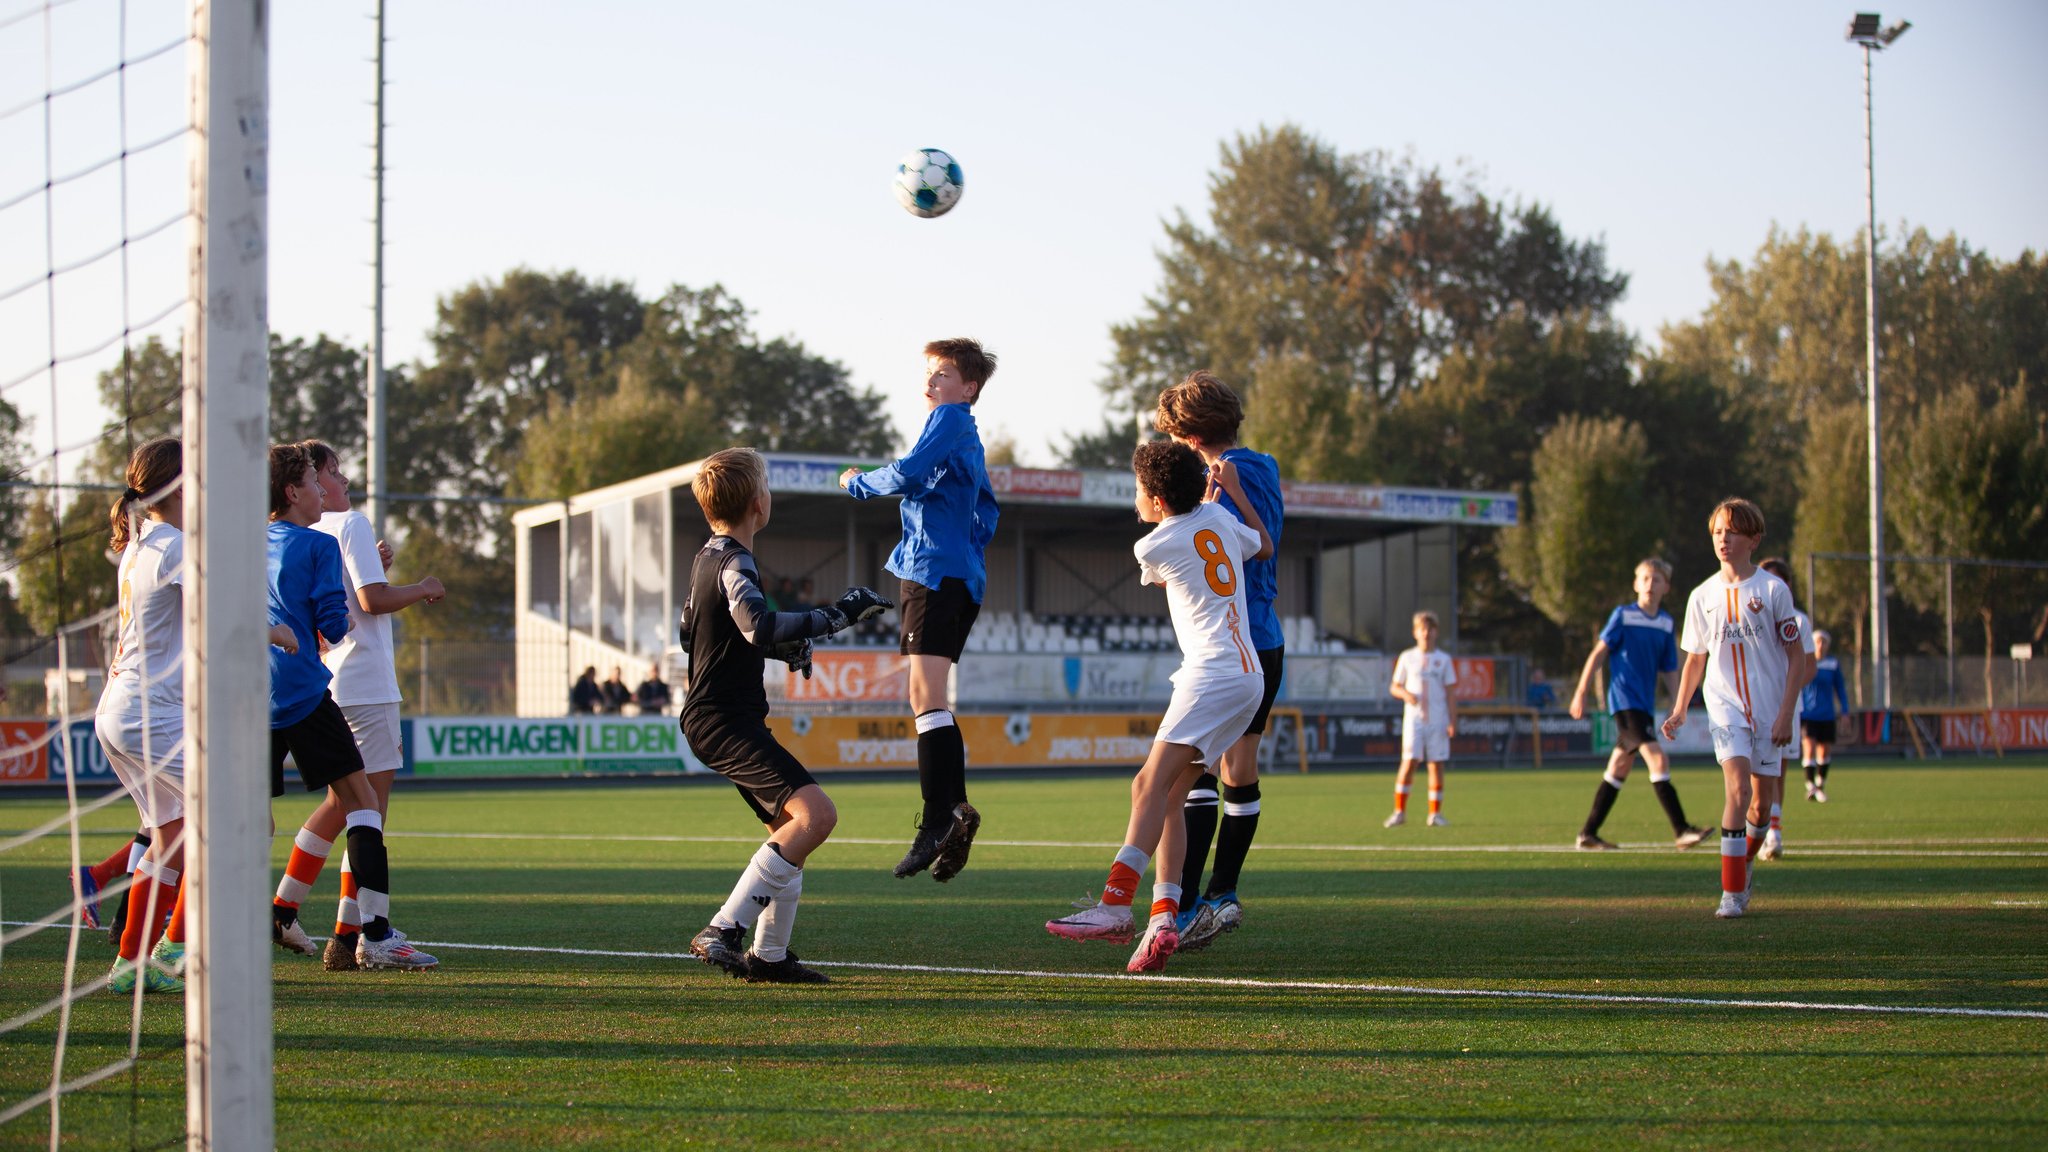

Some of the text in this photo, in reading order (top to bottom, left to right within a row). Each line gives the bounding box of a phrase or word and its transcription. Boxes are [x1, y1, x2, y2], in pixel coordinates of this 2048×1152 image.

[768, 463, 839, 491] ineken
[1194, 529, 1237, 597] 8
[795, 660, 865, 698] ING
[52, 729, 108, 775] STO
[428, 724, 677, 756] VERHAGEN LEIDEN
